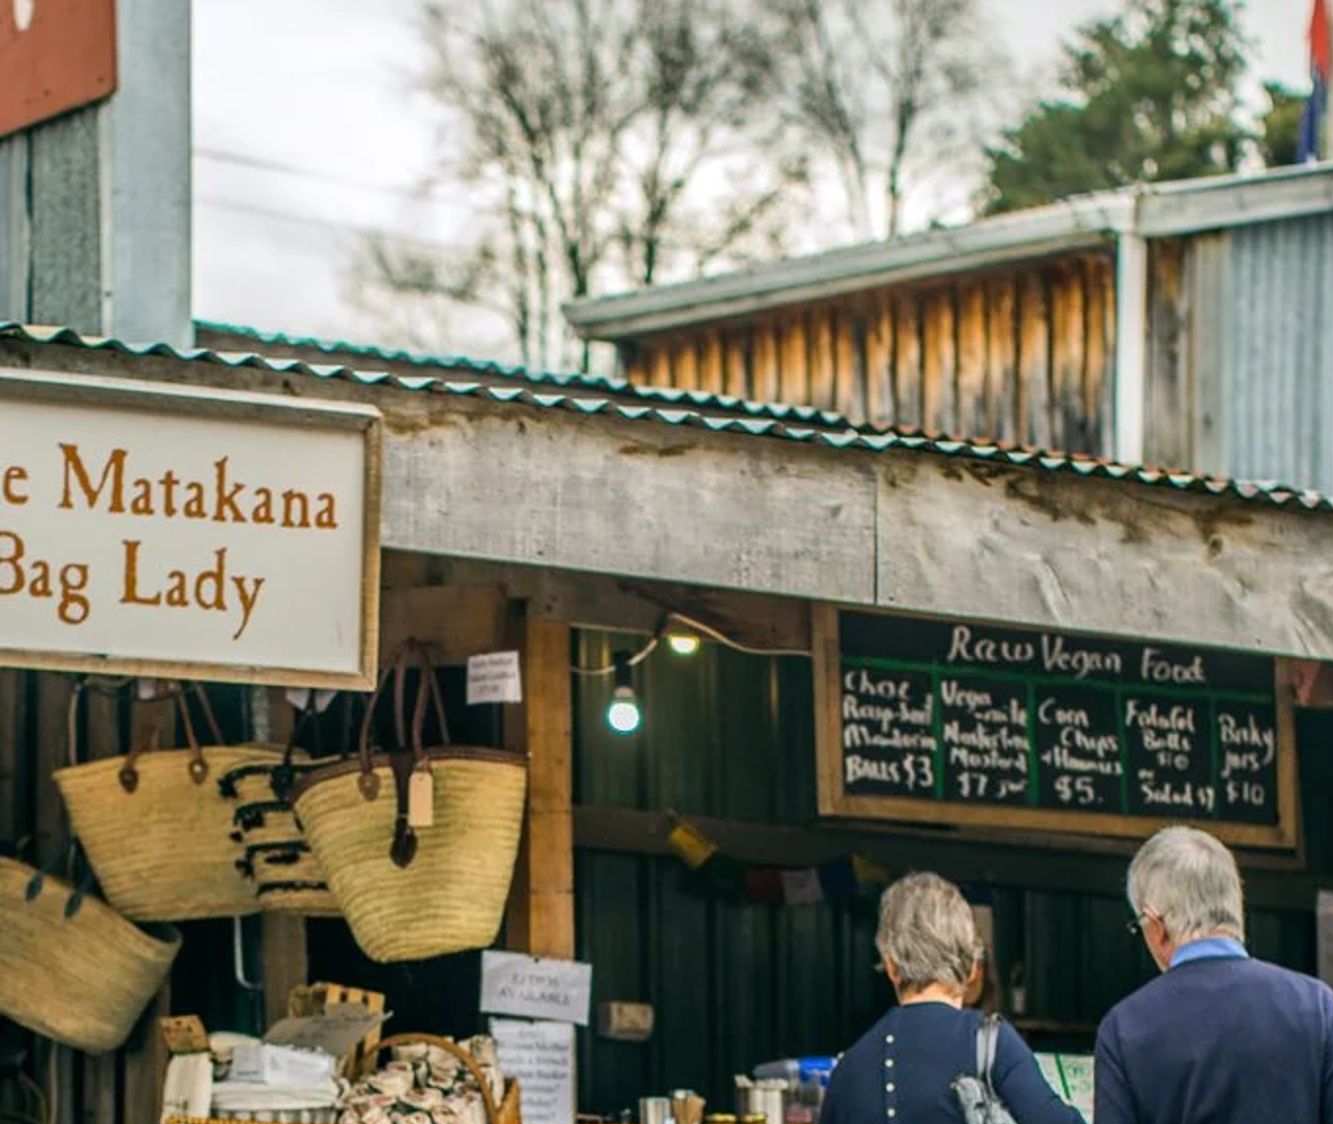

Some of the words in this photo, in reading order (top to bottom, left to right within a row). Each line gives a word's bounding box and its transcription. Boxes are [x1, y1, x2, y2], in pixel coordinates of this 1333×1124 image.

[58, 442, 337, 529] Matakana
[0, 531, 90, 624] Bag
[120, 540, 264, 640] Lady
[948, 625, 1033, 661] Raw
[1042, 634, 1121, 679] Vegan
[1141, 648, 1205, 682] Food
[845, 670, 909, 699] Choc
[1038, 697, 1089, 726] Corn
[1060, 726, 1118, 757] Chips
[904, 753, 933, 790] $3
